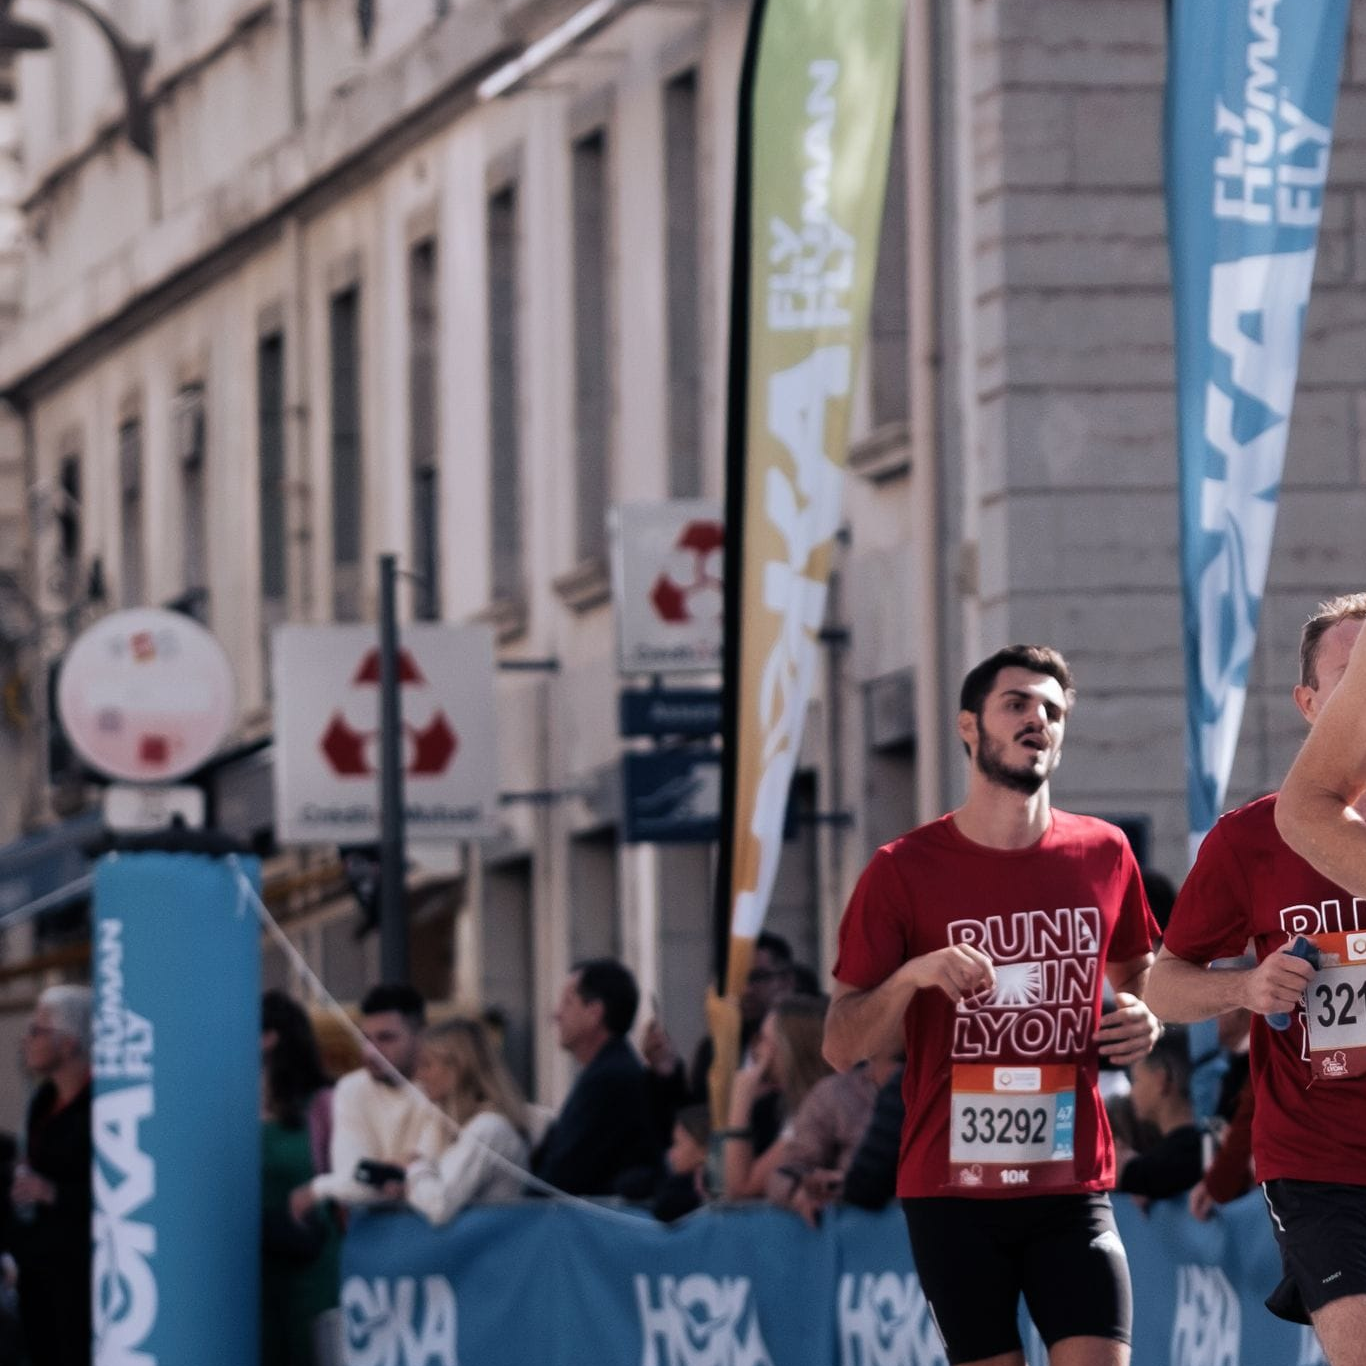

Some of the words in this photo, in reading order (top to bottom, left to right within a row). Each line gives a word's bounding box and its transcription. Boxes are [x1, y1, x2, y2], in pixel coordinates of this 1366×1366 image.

[1276, 95, 1332, 227] FLY
[767, 215, 802, 330] FLY
[1041, 957, 1098, 1006] IN
[122, 1008, 155, 1078] FLY
[951, 1006, 1093, 1058] LYON
[960, 1106, 1048, 1144] 33292
[1000, 1169, 1030, 1184] 10K
